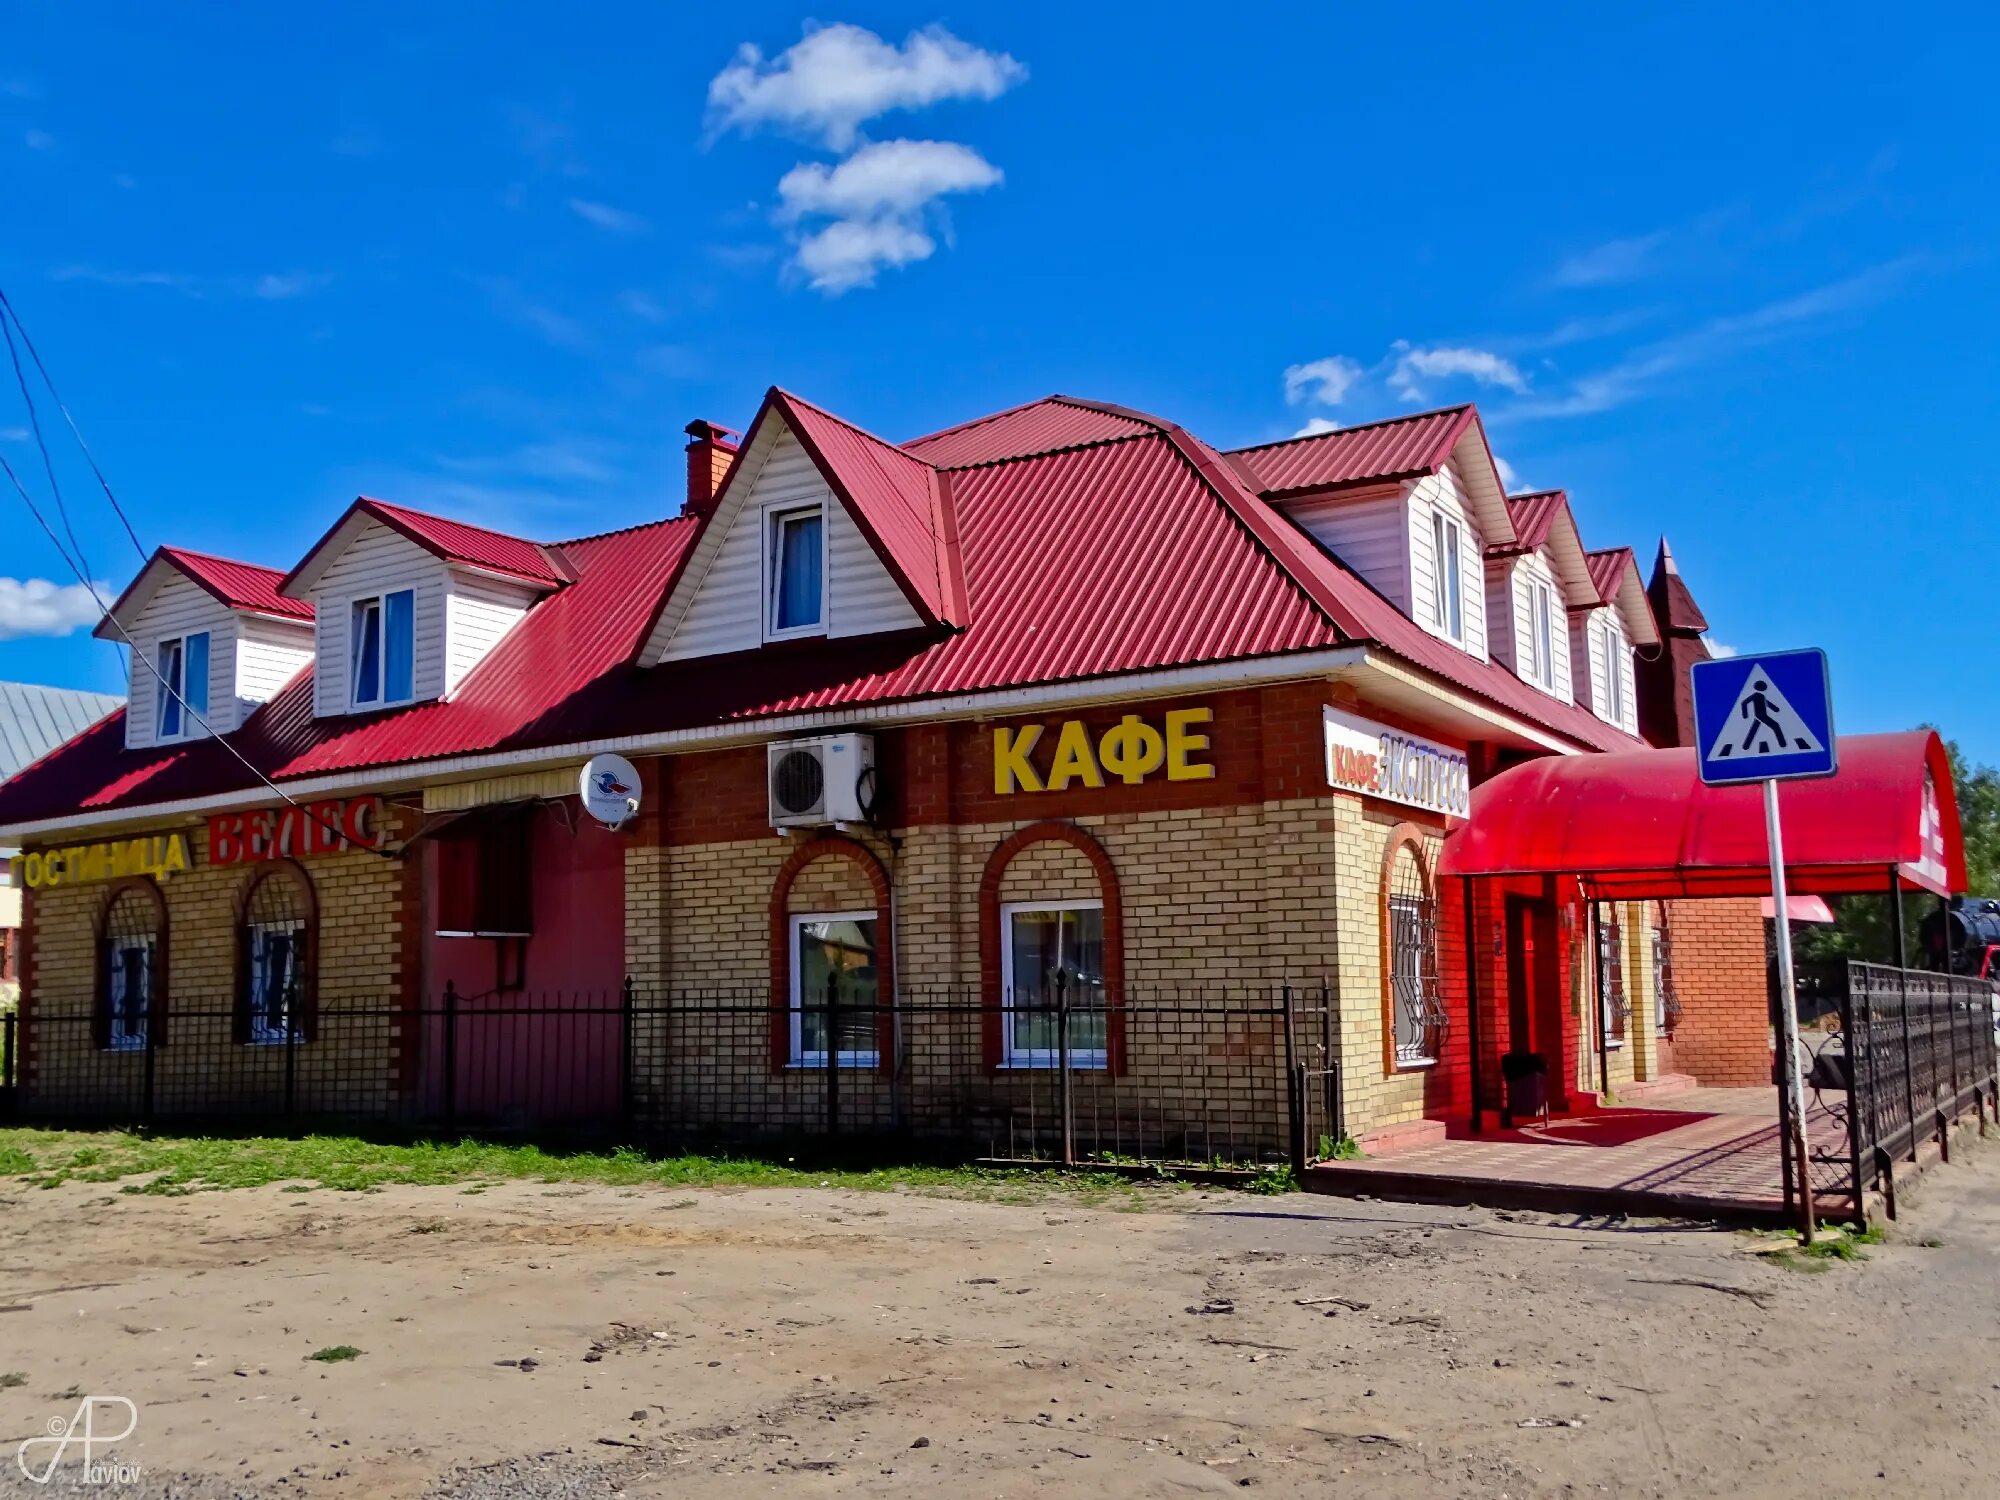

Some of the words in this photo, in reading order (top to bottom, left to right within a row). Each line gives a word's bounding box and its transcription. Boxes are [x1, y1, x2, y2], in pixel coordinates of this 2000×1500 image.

[993, 707, 1215, 794] КАФЕ
[1331, 743, 1379, 793] КАФЕ
[1378, 732, 1469, 813] ЭКСПРЕСС
[9, 834, 190, 888] ГОСТИНИЦА
[208, 795, 386, 866] ВЕЛЕС
